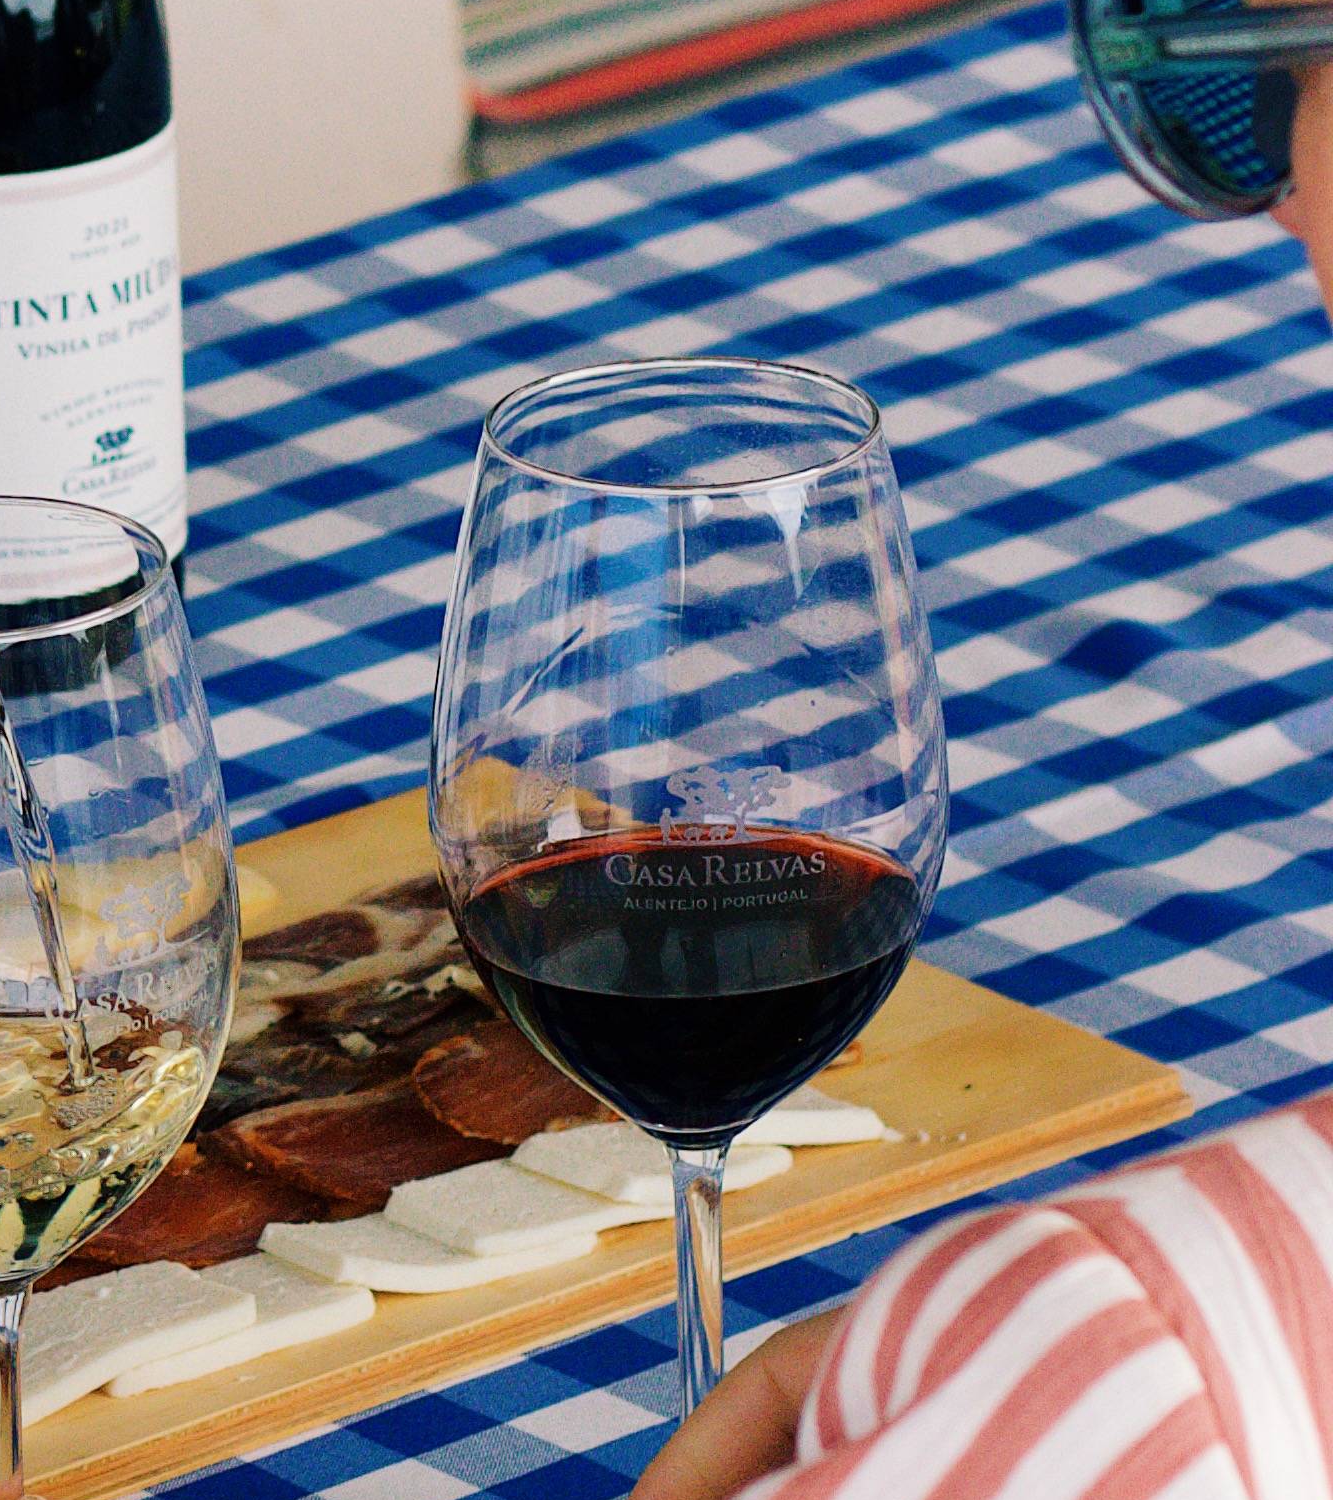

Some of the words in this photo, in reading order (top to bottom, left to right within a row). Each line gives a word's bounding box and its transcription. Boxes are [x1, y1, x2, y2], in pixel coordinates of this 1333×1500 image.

[604, 853, 699, 888] CASA
[700, 850, 827, 887] RELVAS
[622, 895, 709, 912] ALENTEJO
[721, 887, 810, 910] PORTUGAL
